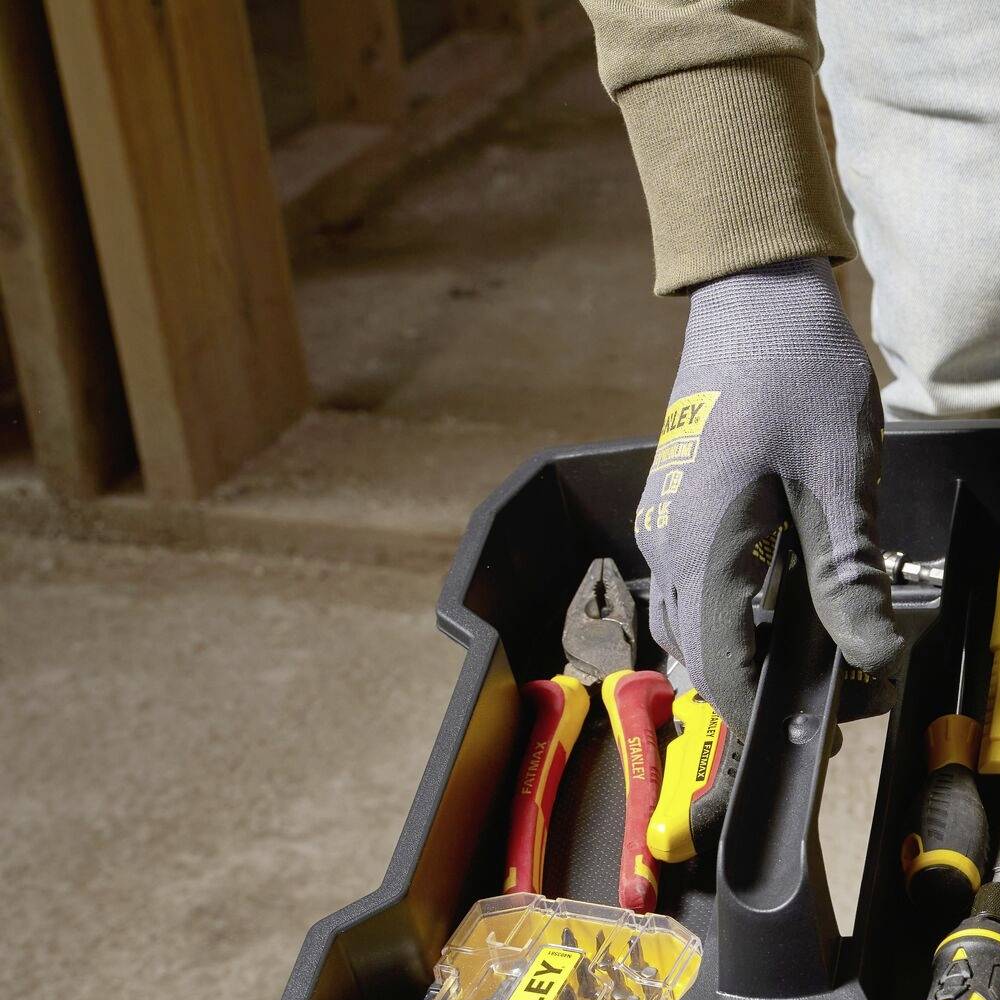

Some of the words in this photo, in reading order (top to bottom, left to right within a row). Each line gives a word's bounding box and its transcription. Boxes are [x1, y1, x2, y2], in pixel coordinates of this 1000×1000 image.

[522, 741, 547, 795] FATMAX
[627, 736, 646, 781] STANLEY
[697, 743, 712, 778] FATMAX
